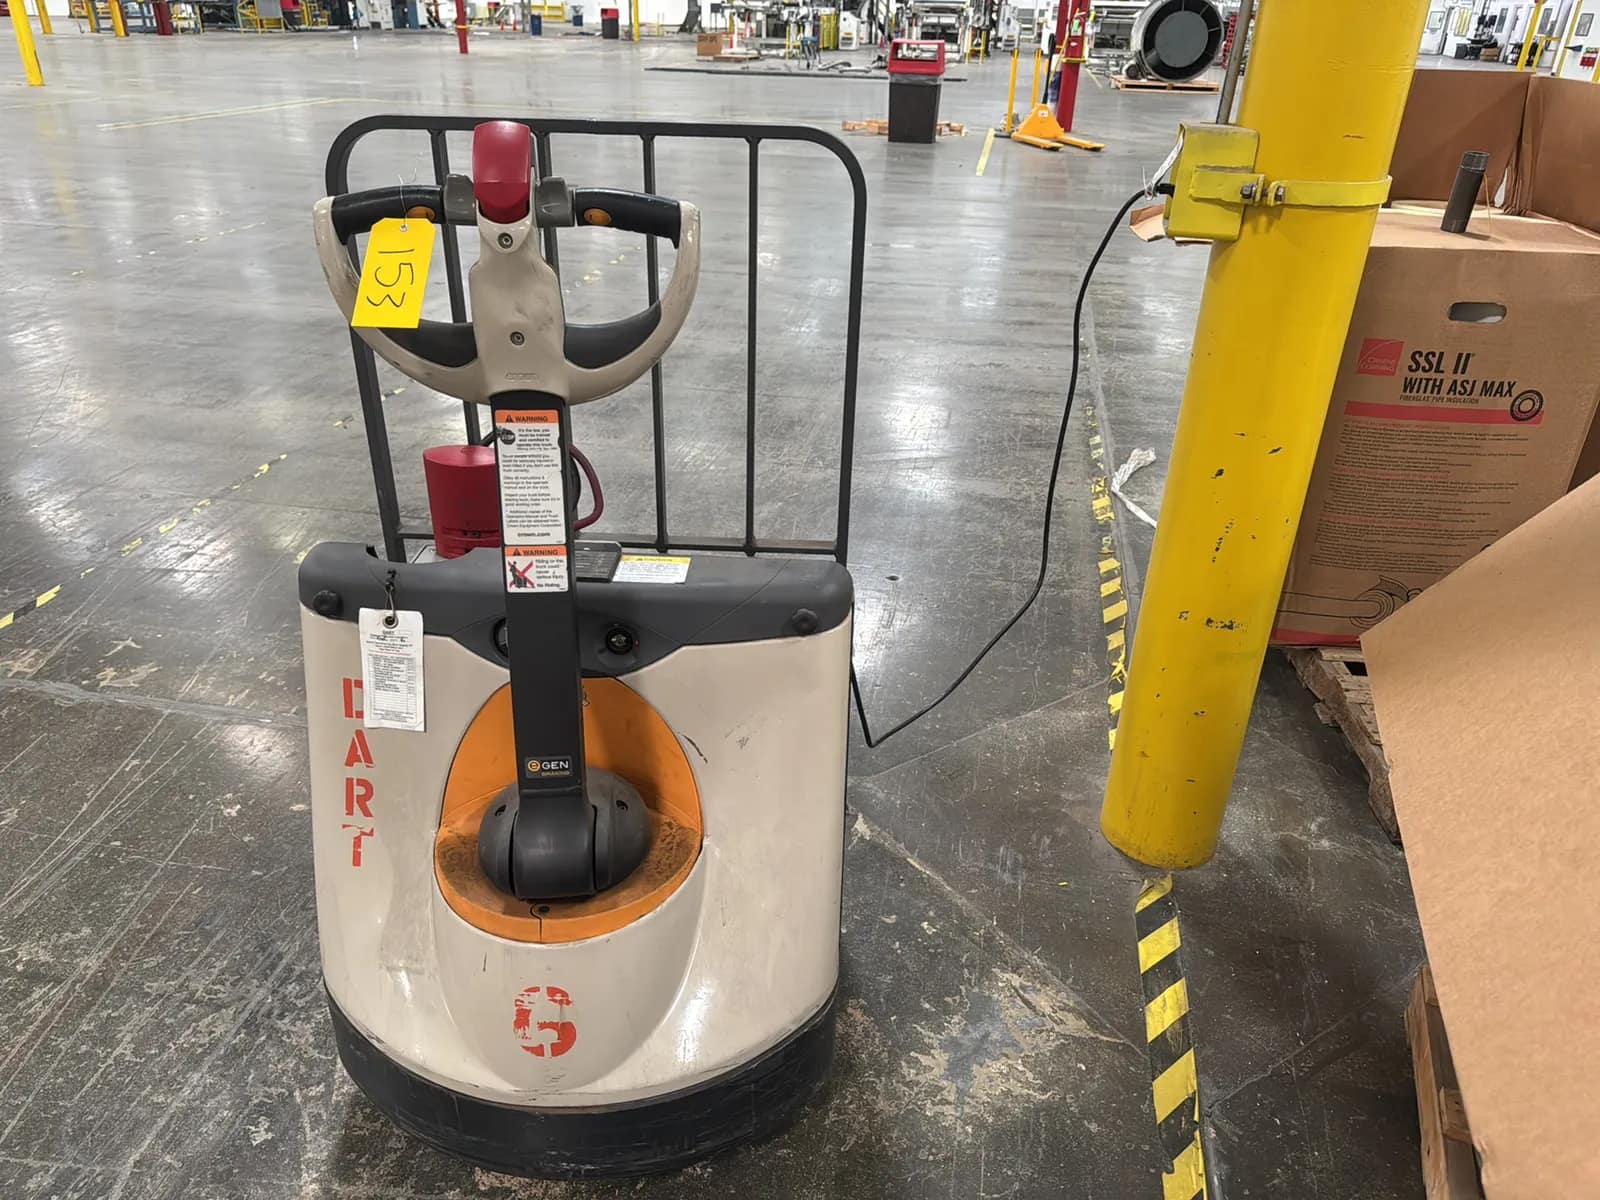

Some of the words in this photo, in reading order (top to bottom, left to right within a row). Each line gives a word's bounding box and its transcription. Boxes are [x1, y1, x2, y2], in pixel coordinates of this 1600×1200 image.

[366, 248, 416, 308] 153
[1407, 350, 1446, 374] SSL
[1403, 377, 1445, 395] WITH
[1446, 379, 1477, 397] ASJ
[1480, 380, 1518, 398] MAX
[514, 415, 548, 424] WARNING
[514, 986, 577, 1058] 6
